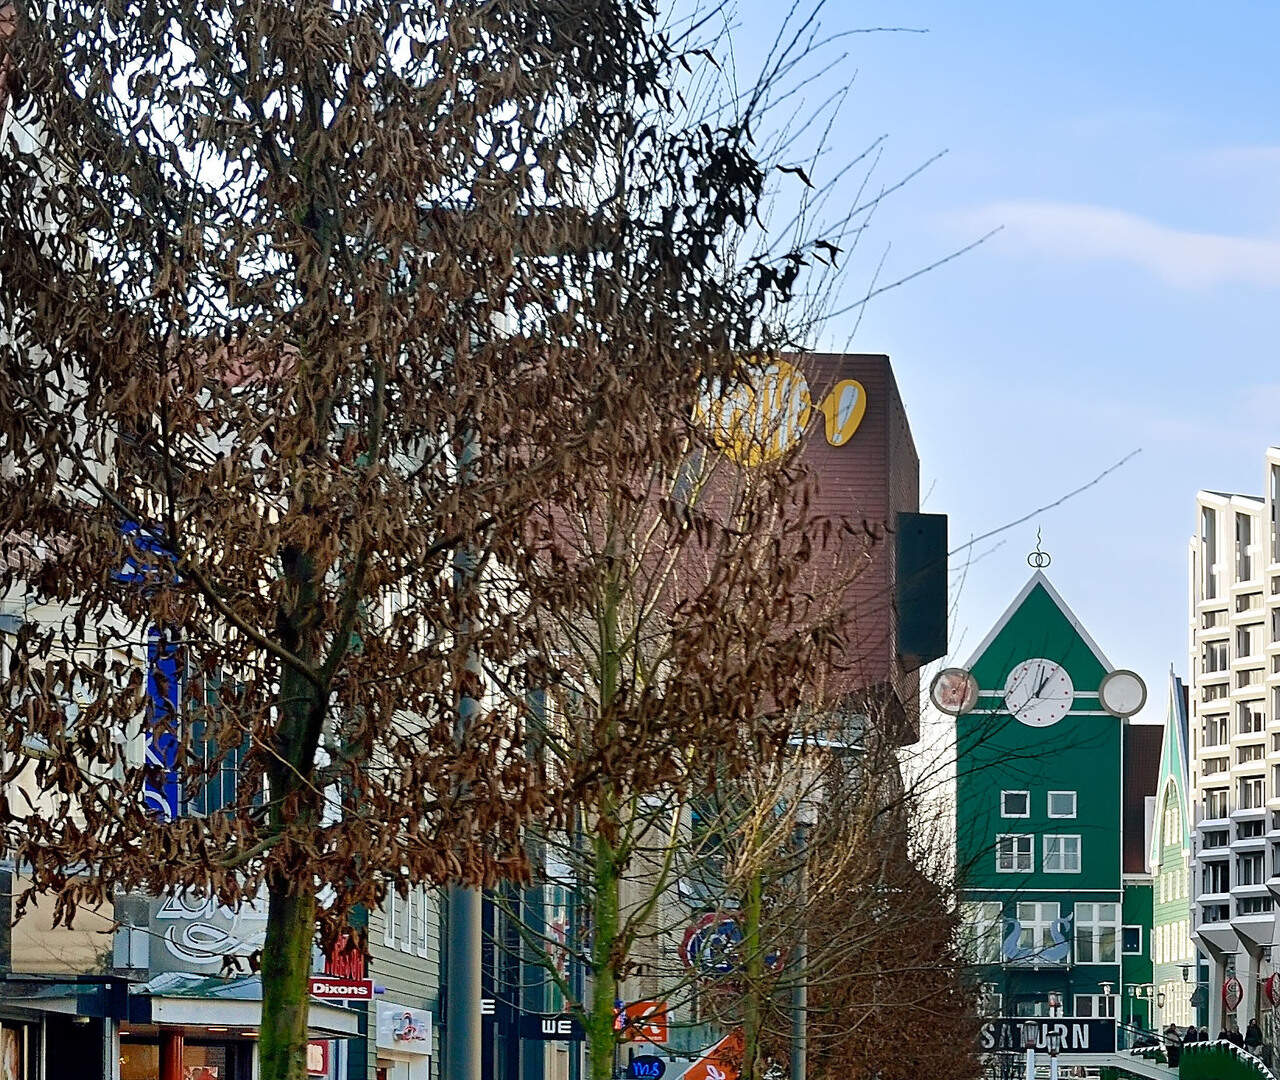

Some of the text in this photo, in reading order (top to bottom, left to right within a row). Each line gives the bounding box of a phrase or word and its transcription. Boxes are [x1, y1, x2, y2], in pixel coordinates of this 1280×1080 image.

[312, 983, 368, 995] Dixons
[480, 999, 495, 1014] E
[541, 1020, 572, 1034] WE
